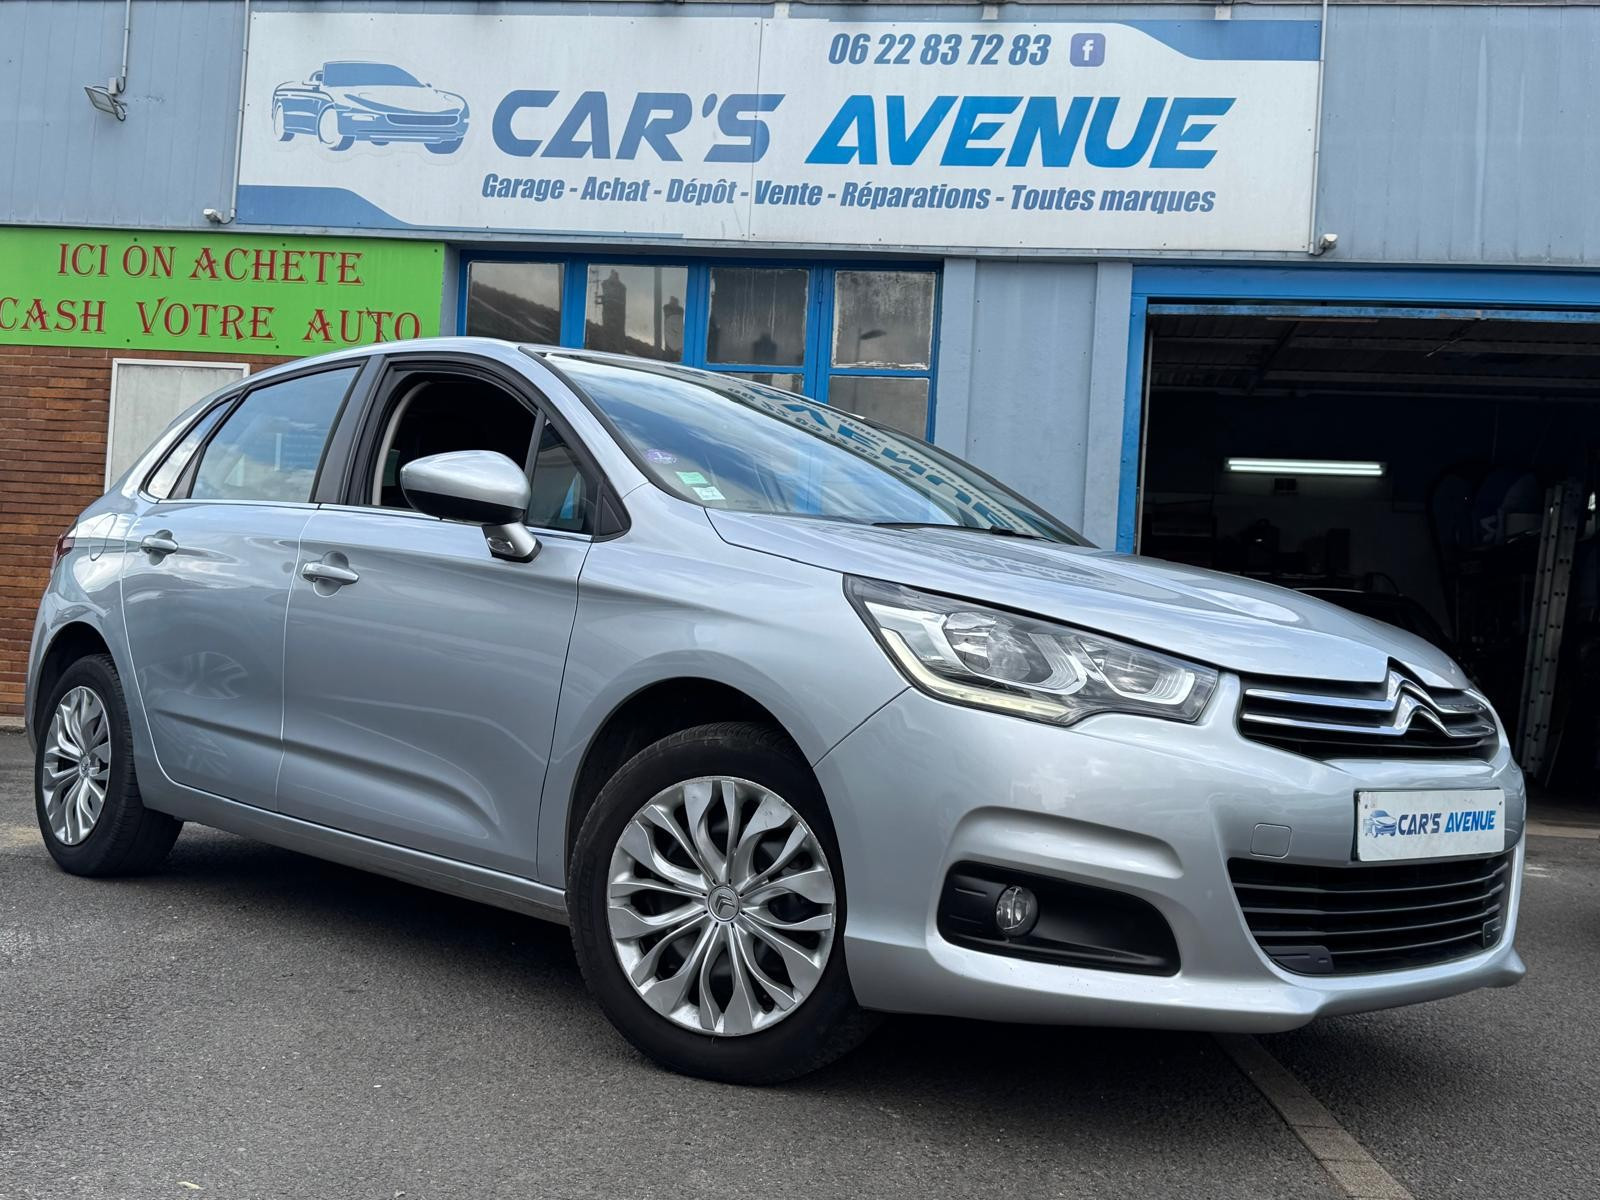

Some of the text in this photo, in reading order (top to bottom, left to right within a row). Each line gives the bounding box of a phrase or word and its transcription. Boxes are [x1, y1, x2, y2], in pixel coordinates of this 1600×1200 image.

[828, 33, 1052, 65] 06 22 83 72 83
[492, 89, 1237, 169] CAR'S AVENUE
[482, 173, 565, 202] Garage
[581, 176, 650, 202] Achat
[665, 178, 738, 206] Dépôt
[754, 180, 823, 206] Vente
[840, 181, 991, 211] Réparations
[1011, 184, 1095, 213] Toutes
[1098, 189, 1216, 214] marques
[58, 243, 364, 286] ICI ON ACHETE
[0, 296, 422, 344] CASH VOTRE AUTO
[1398, 810, 1497, 836] CAR'S AVENUE
